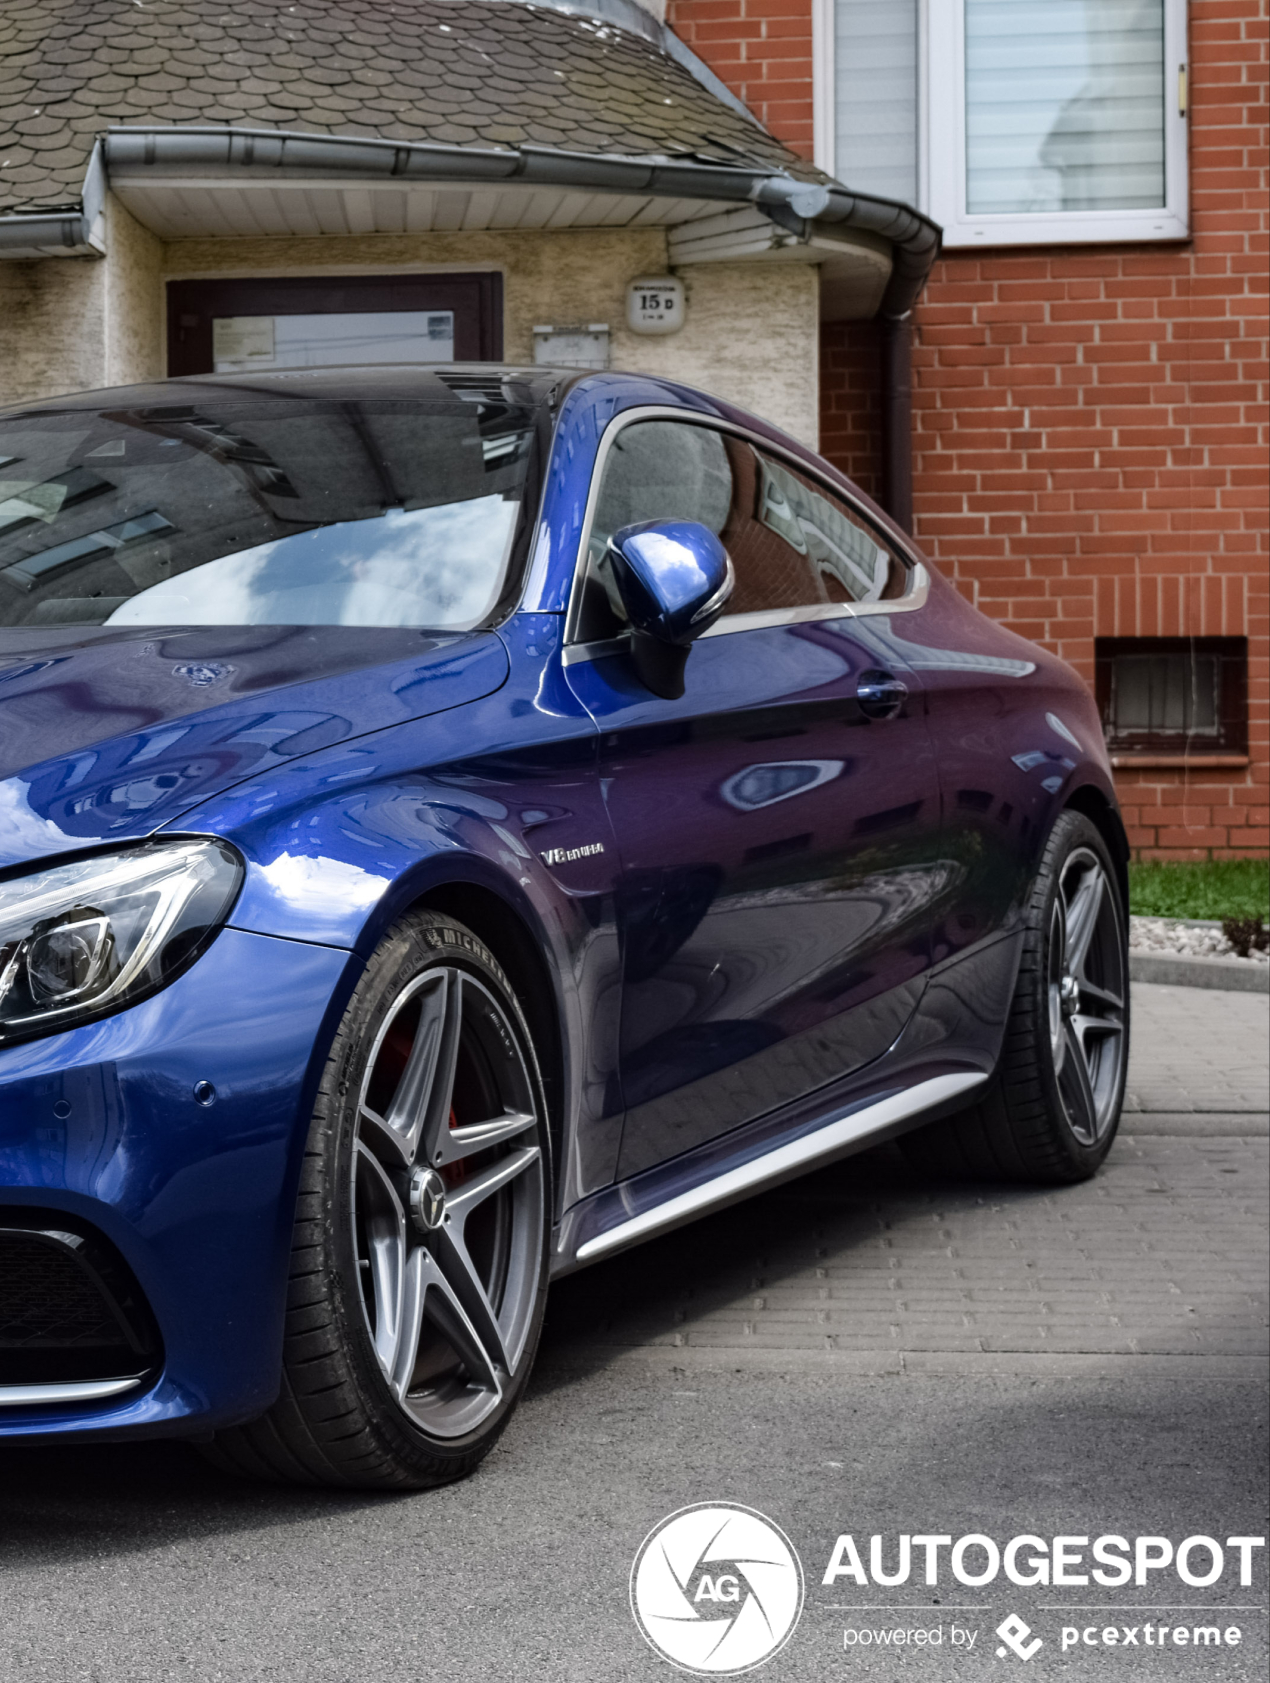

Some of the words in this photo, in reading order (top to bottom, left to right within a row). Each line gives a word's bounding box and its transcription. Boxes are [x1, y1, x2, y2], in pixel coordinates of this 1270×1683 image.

[640, 294, 660, 310] 15
[664, 298, 674, 310] D
[540, 847, 566, 866] V8
[443, 928, 512, 995] MICHELIN
